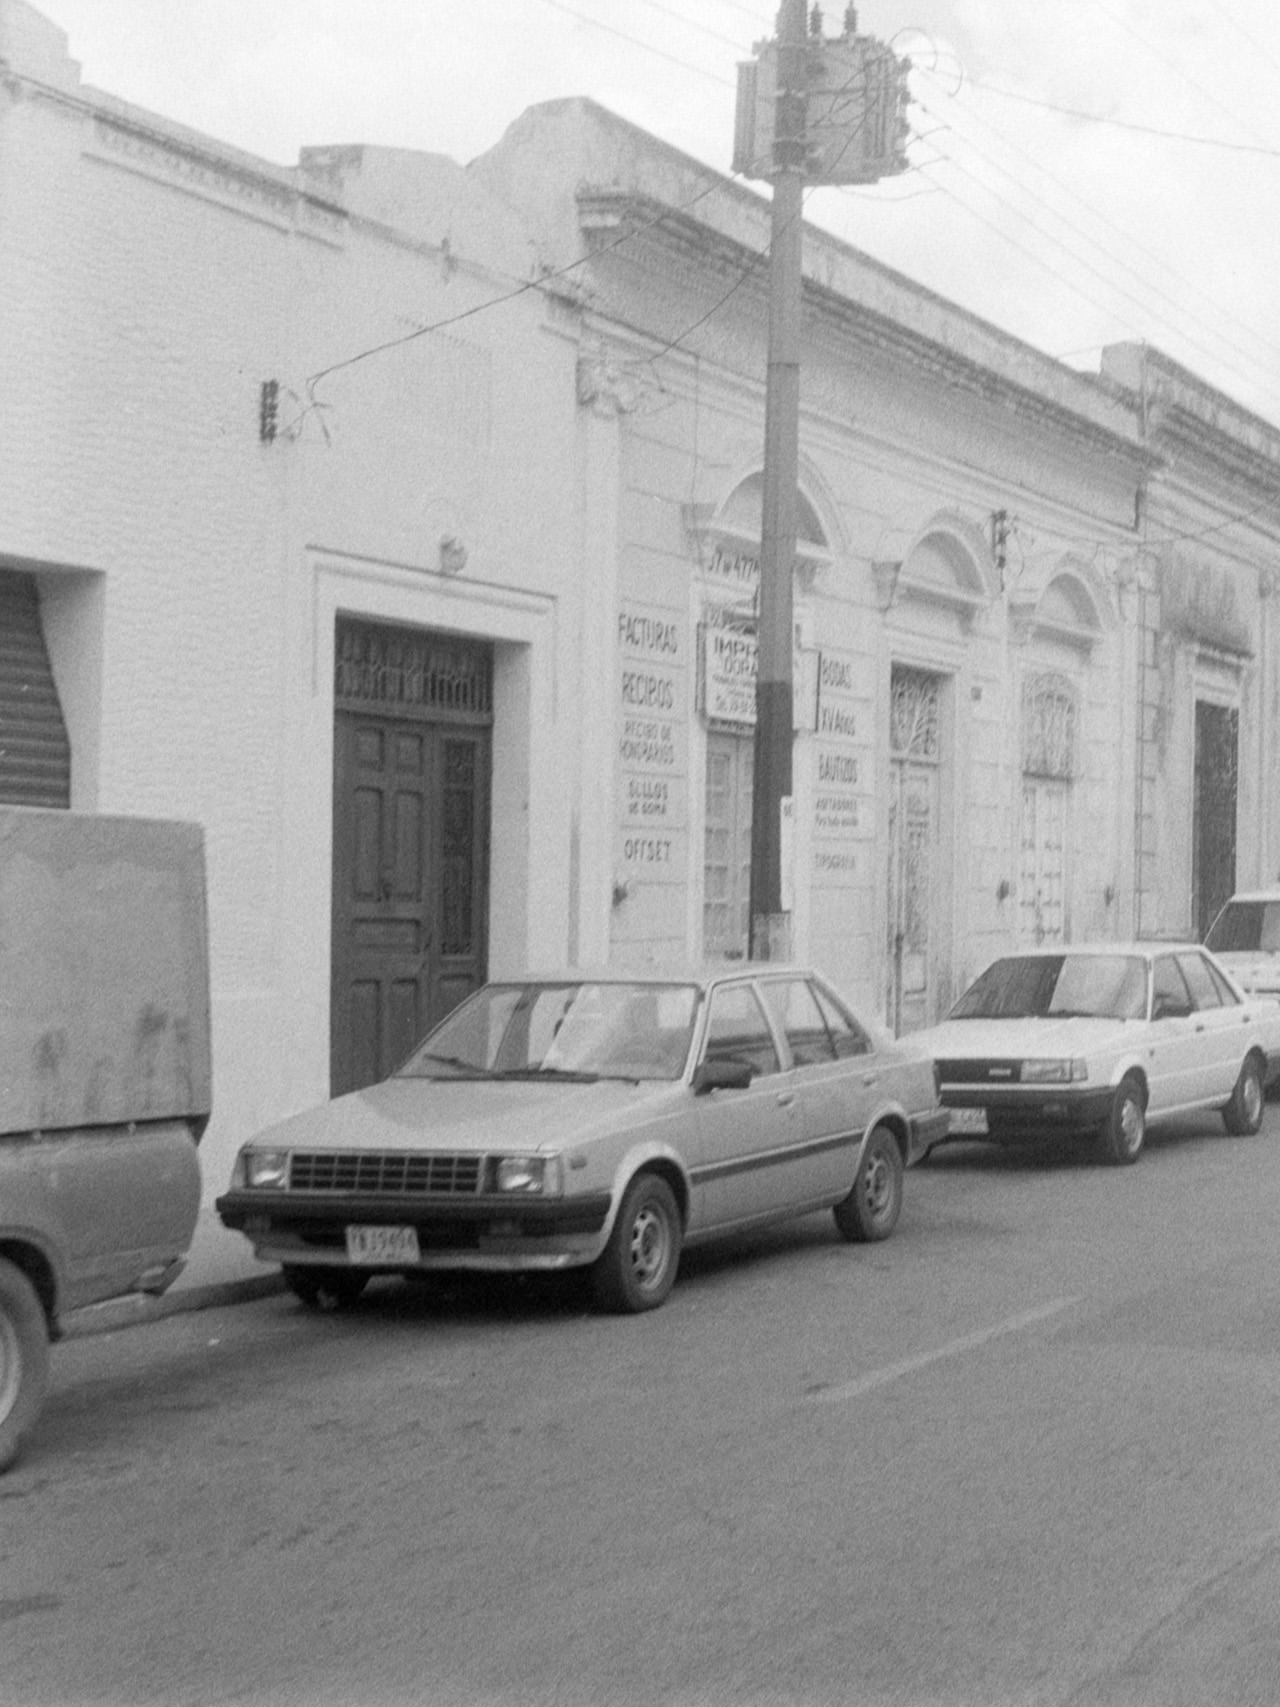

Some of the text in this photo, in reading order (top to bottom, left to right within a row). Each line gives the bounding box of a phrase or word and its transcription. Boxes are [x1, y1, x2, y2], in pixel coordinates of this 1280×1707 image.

[618, 612, 678, 654] FACTURAS
[622, 671, 674, 710] RECIBOS
[623, 838, 671, 861] OFFSET
